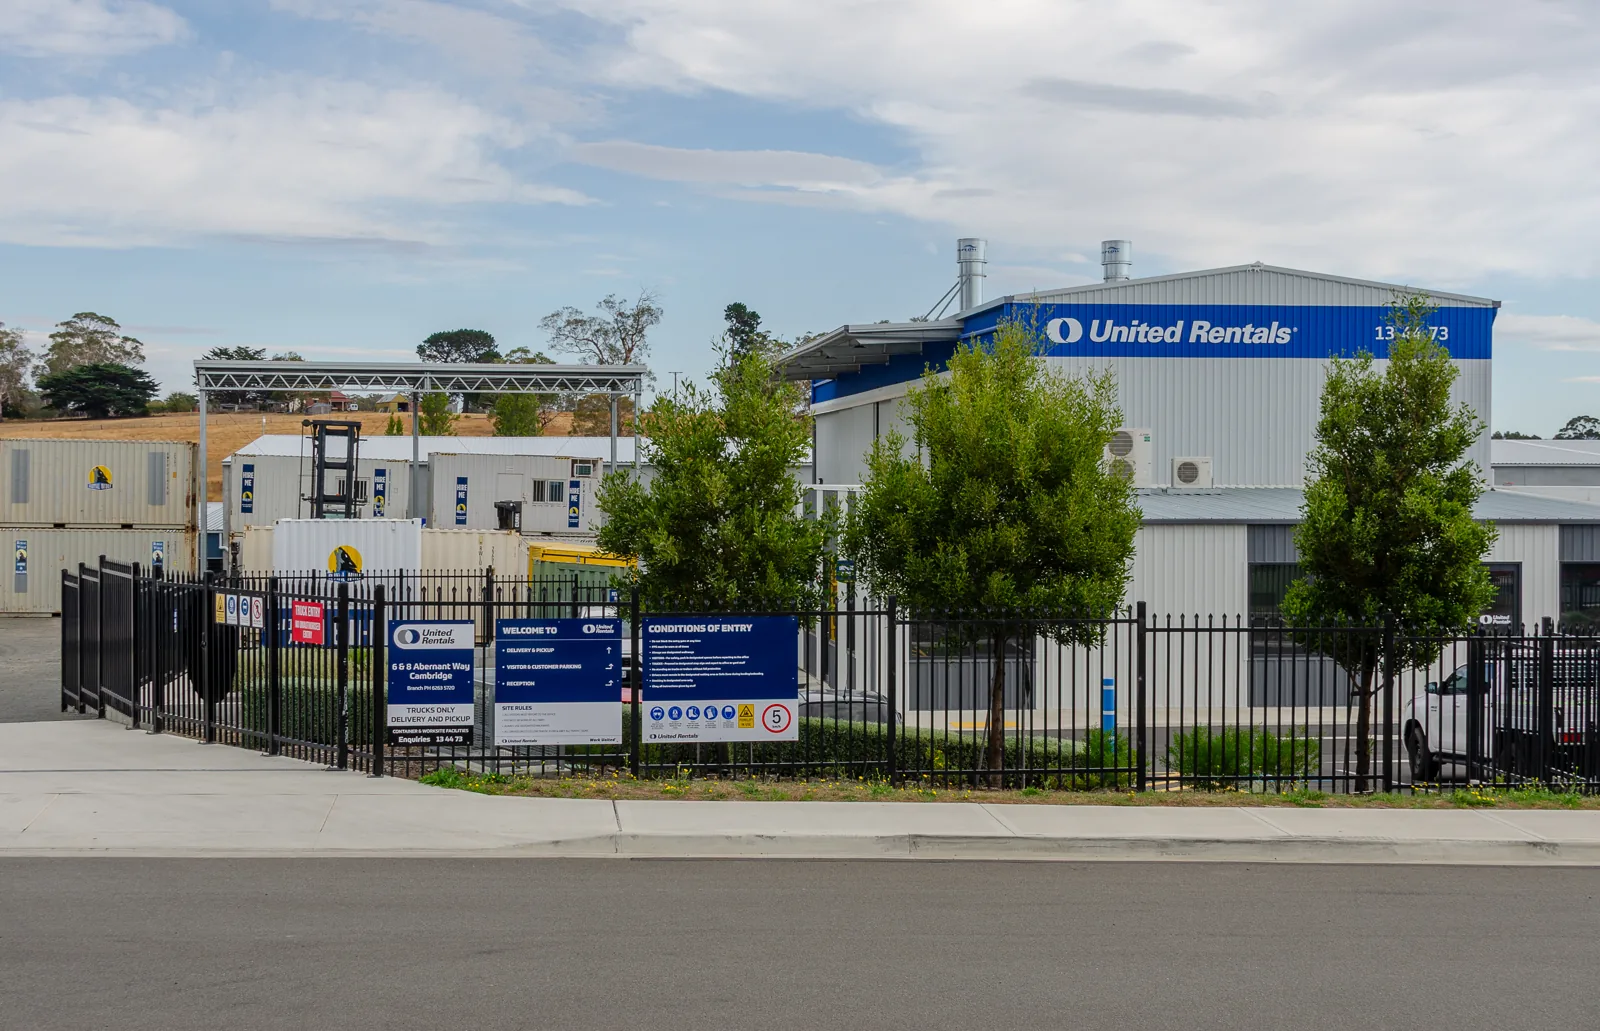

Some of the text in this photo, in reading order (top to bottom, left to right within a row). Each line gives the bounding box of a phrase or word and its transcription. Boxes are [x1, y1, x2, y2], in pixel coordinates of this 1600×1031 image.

[1089, 319, 1292, 344] United Rentals
[1375, 326, 1395, 340] 13
[1429, 326, 1449, 341] 73
[295, 605, 321, 618] TRUCK ENTRY
[502, 626, 558, 634] WELCOME TO
[648, 623, 753, 633] CONDITIONS OF ENTRY
[422, 629, 453, 637] United
[421, 637, 455, 645] Rentals
[413, 663, 451, 671] Abernant
[452, 662, 470, 671] Way
[409, 672, 453, 680] Cambridge
[772, 709, 781, 724] 5
[398, 736, 431, 744] Enquiries
